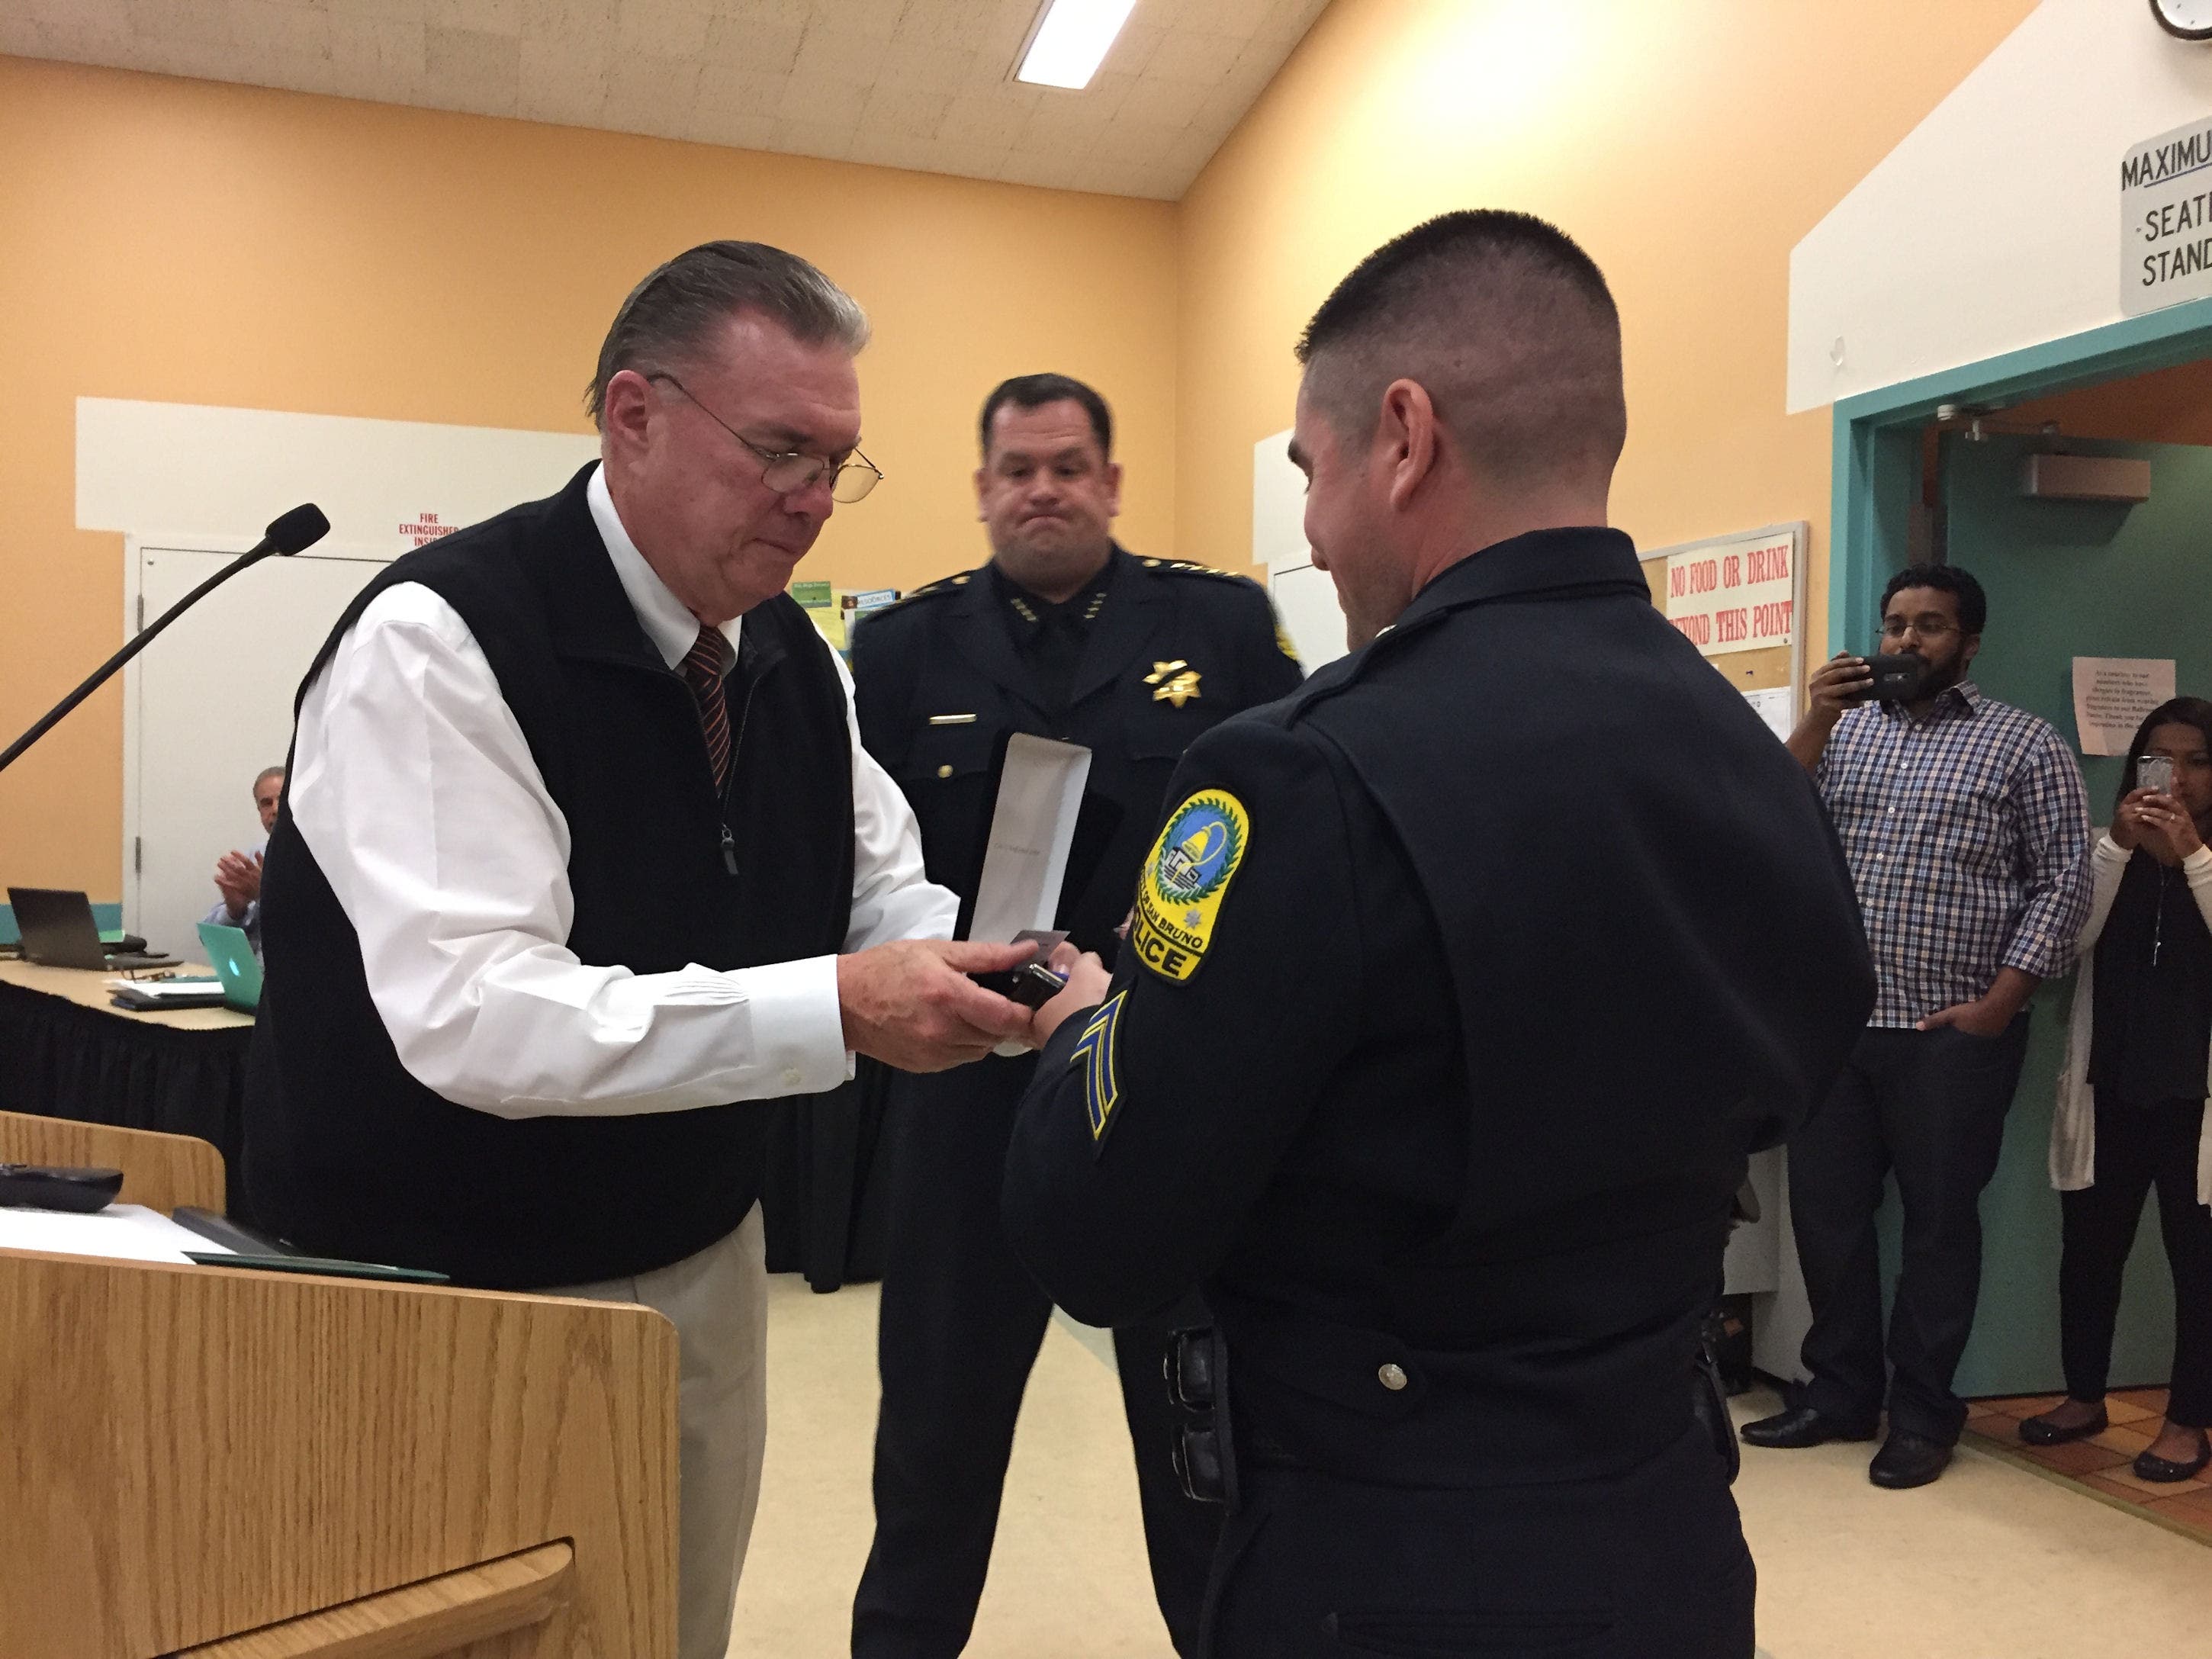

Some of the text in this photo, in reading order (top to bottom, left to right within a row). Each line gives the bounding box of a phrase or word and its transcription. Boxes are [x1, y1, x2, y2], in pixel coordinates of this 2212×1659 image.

[420, 513, 439, 524] FIRE
[1670, 545, 1789, 598] NO FOOD OR DRINK
[1715, 608, 1747, 643] THIS
[1753, 600, 1795, 638] POINT
[1158, 917, 1204, 949] BRUNO
